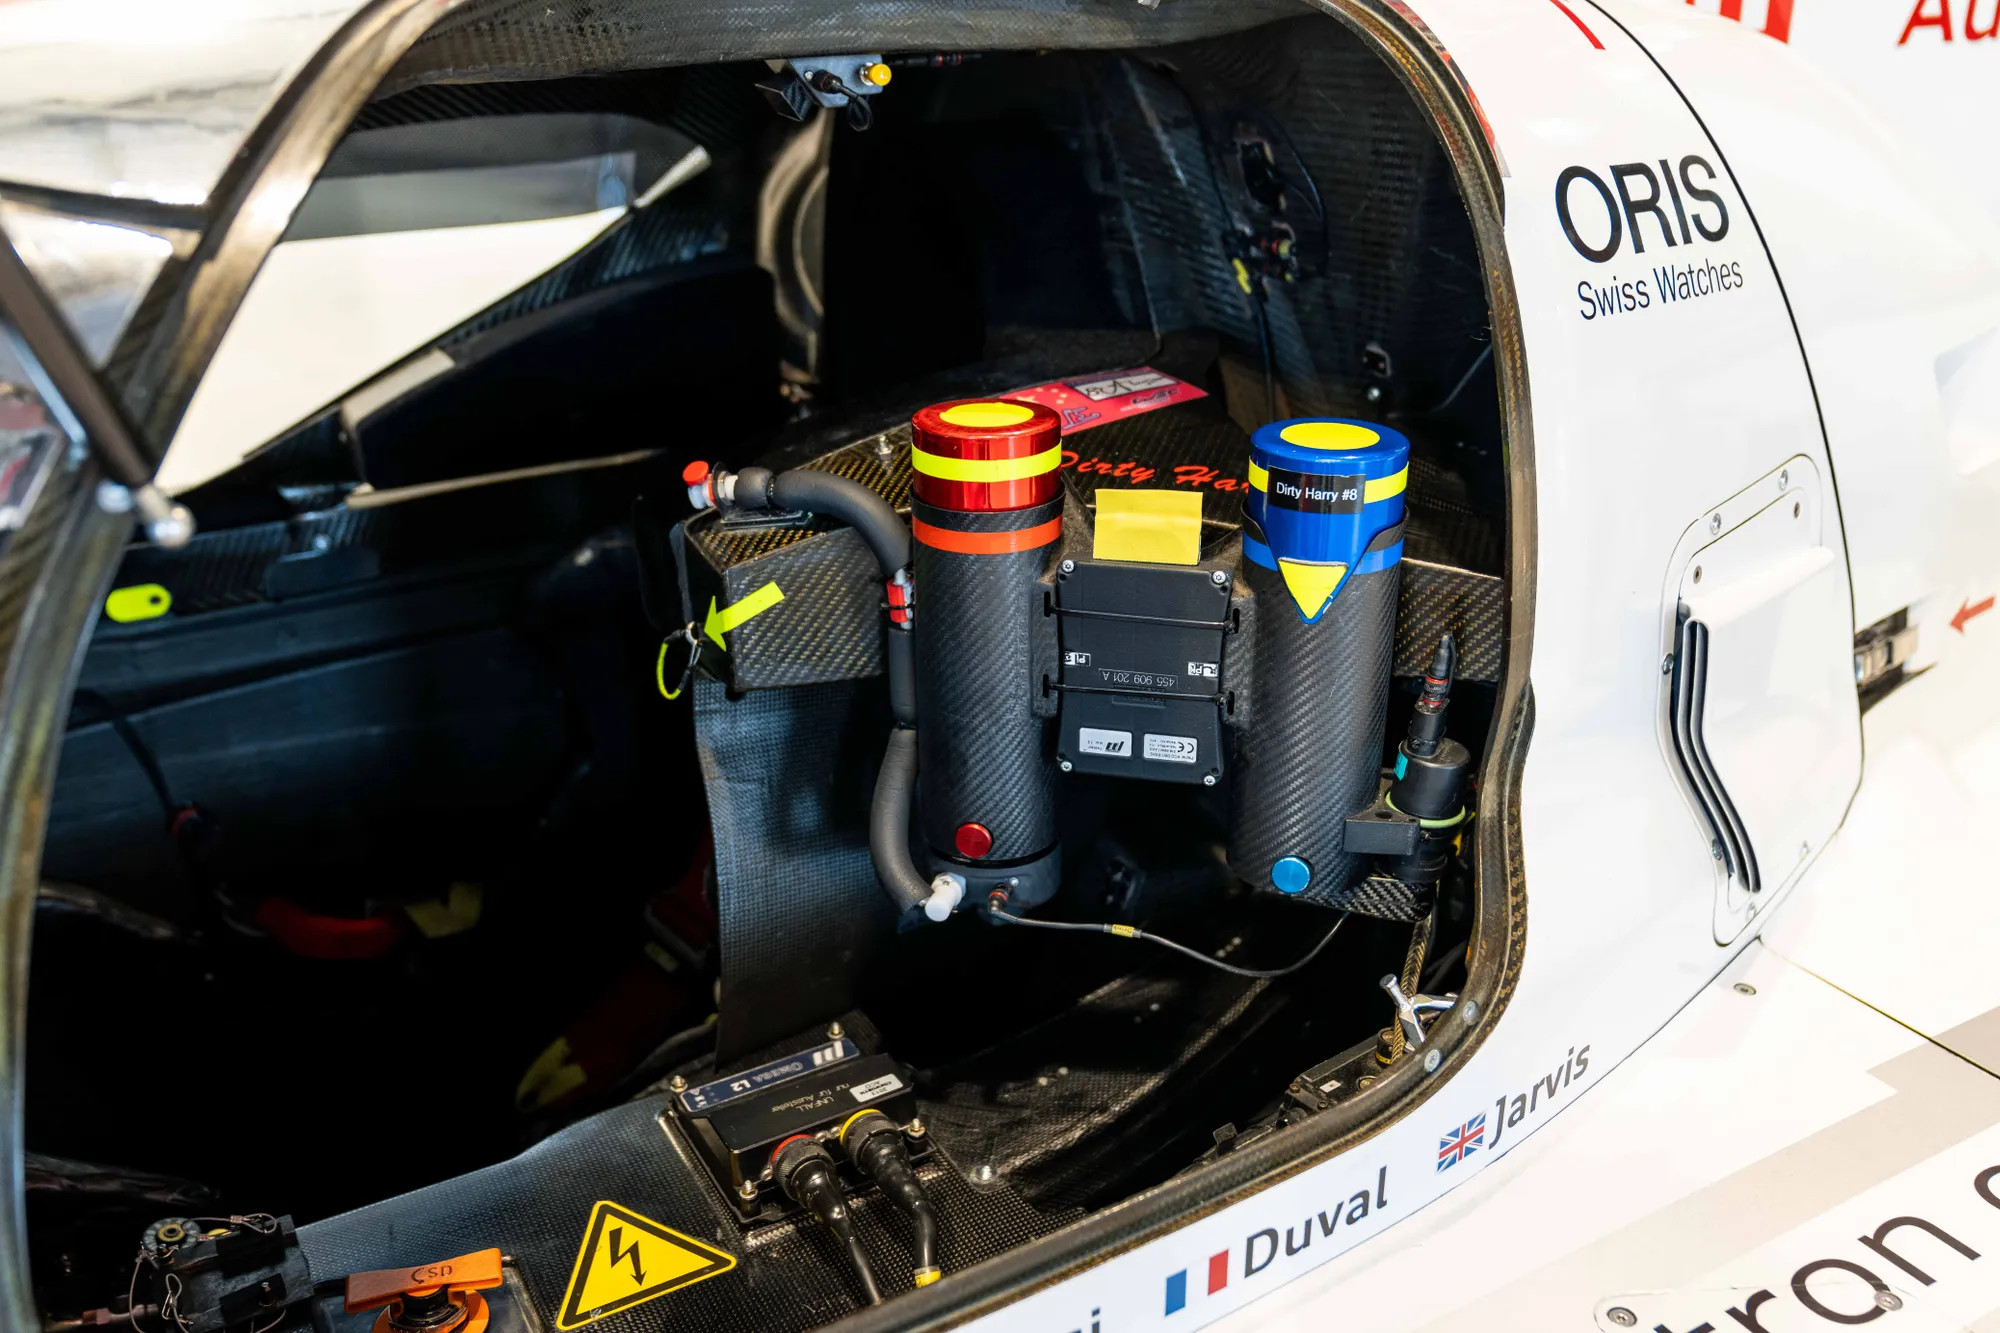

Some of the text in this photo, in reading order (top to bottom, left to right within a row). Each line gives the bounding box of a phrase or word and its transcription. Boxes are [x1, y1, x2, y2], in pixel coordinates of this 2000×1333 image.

[1555, 154, 1730, 264] ORIS
[1577, 257, 1744, 321] Swiss Watches
[1276, 481, 1358, 503] Dirty Harry #8
[1102, 671, 1176, 687] 455 909 201 A
[730, 1079, 751, 1092] L2
[796, 1096, 834, 1112] UNFALL
[1487, 1043, 1592, 1150] Jarvis
[1244, 1165, 1388, 1278] Duval
[1653, 1215, 1982, 1333] ron
